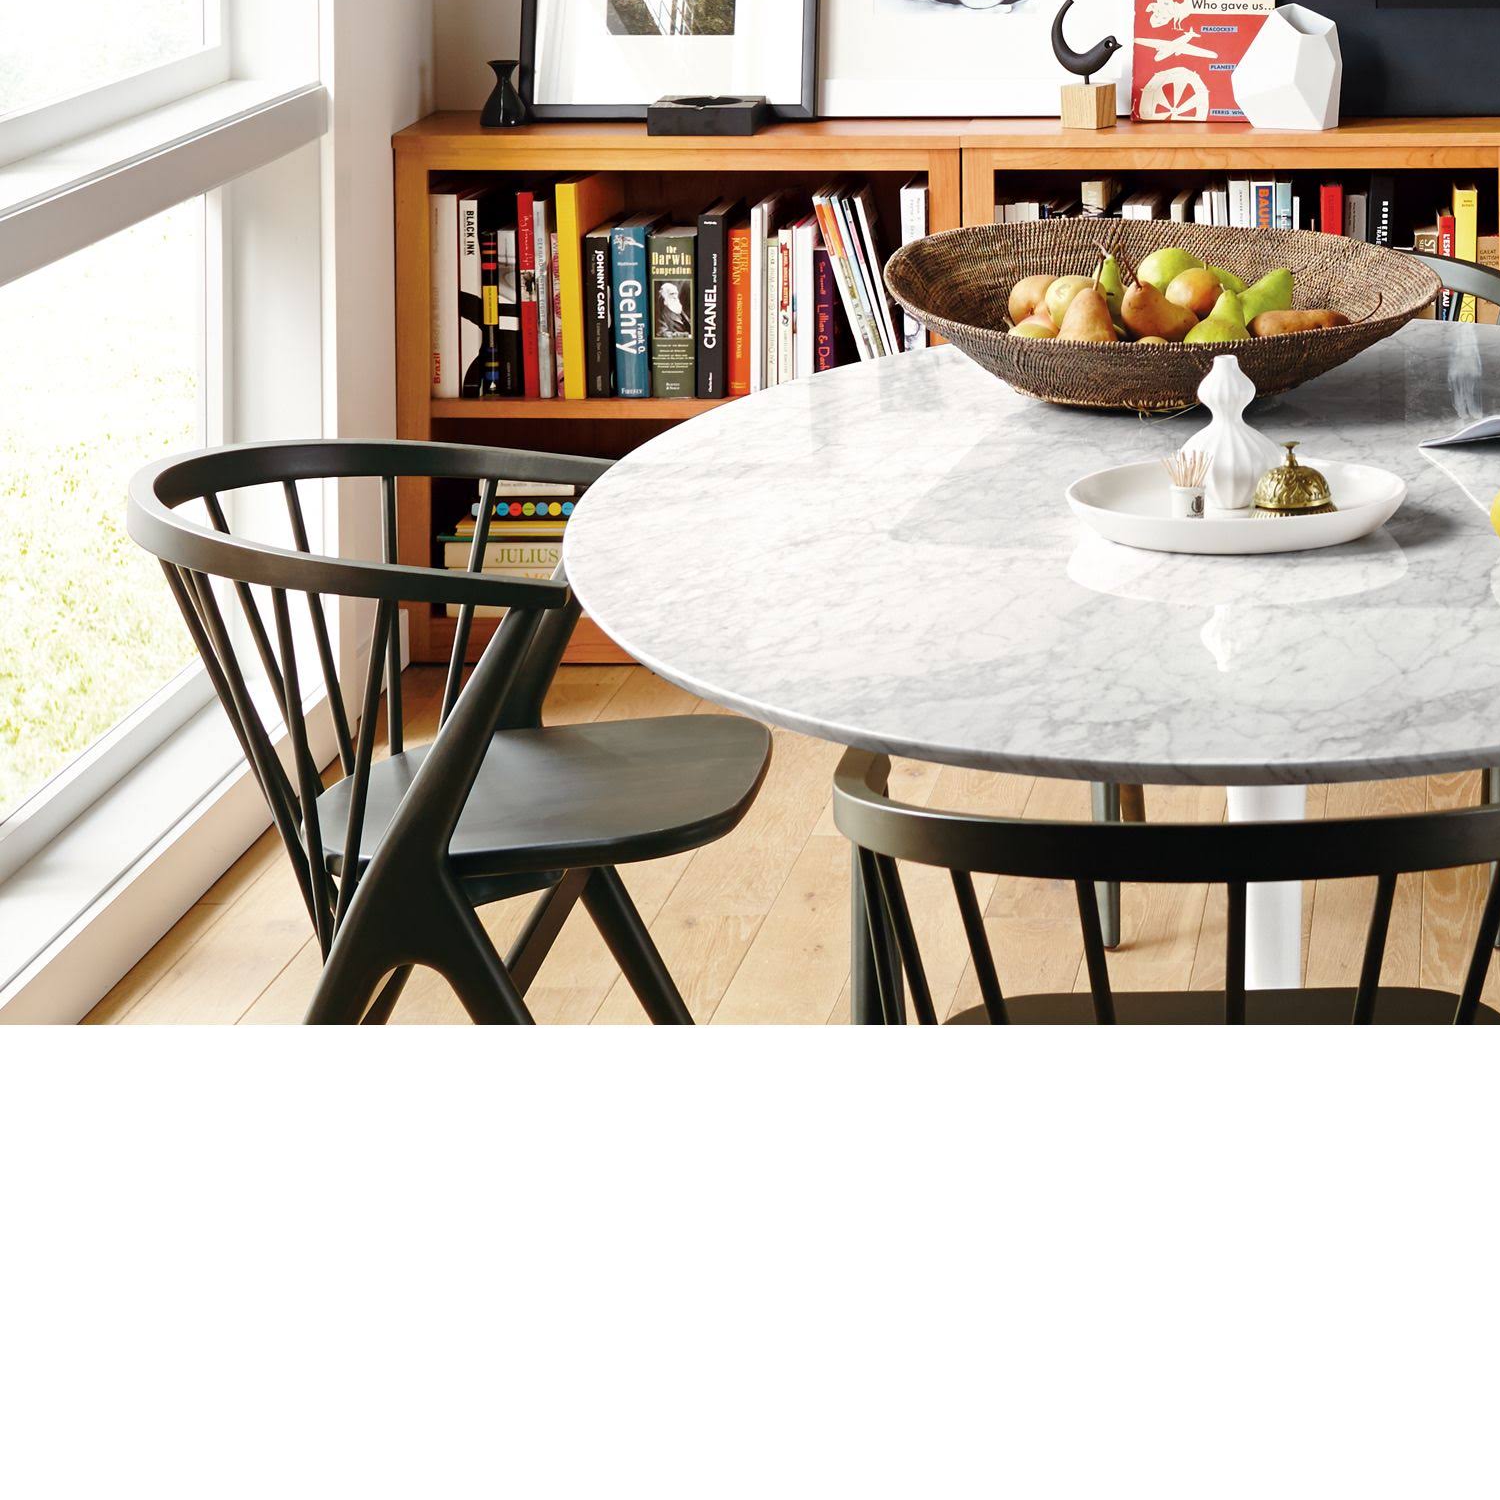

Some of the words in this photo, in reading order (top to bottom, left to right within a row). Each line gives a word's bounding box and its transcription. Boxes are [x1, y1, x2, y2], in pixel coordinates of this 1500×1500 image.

[1191, 0, 1217, 10] Who
[1221, 3, 1248, 12] gave
[466, 210, 475, 238] BLACK
[466, 240, 476, 256] INK
[652, 252, 692, 265] Darwin
[595, 250, 605, 290] JOHNNY
[597, 291, 606, 319] CASH
[616, 279, 643, 354] Gehry
[703, 285, 717, 349] CHANEL
[817, 304, 830, 332] Lillian
[637, 323, 645, 344] Frank
[818, 335, 829, 343] &
[637, 345, 646, 354] O.
[433, 353, 441, 385] Brazil
[495, 548, 559, 564] JULIUS
